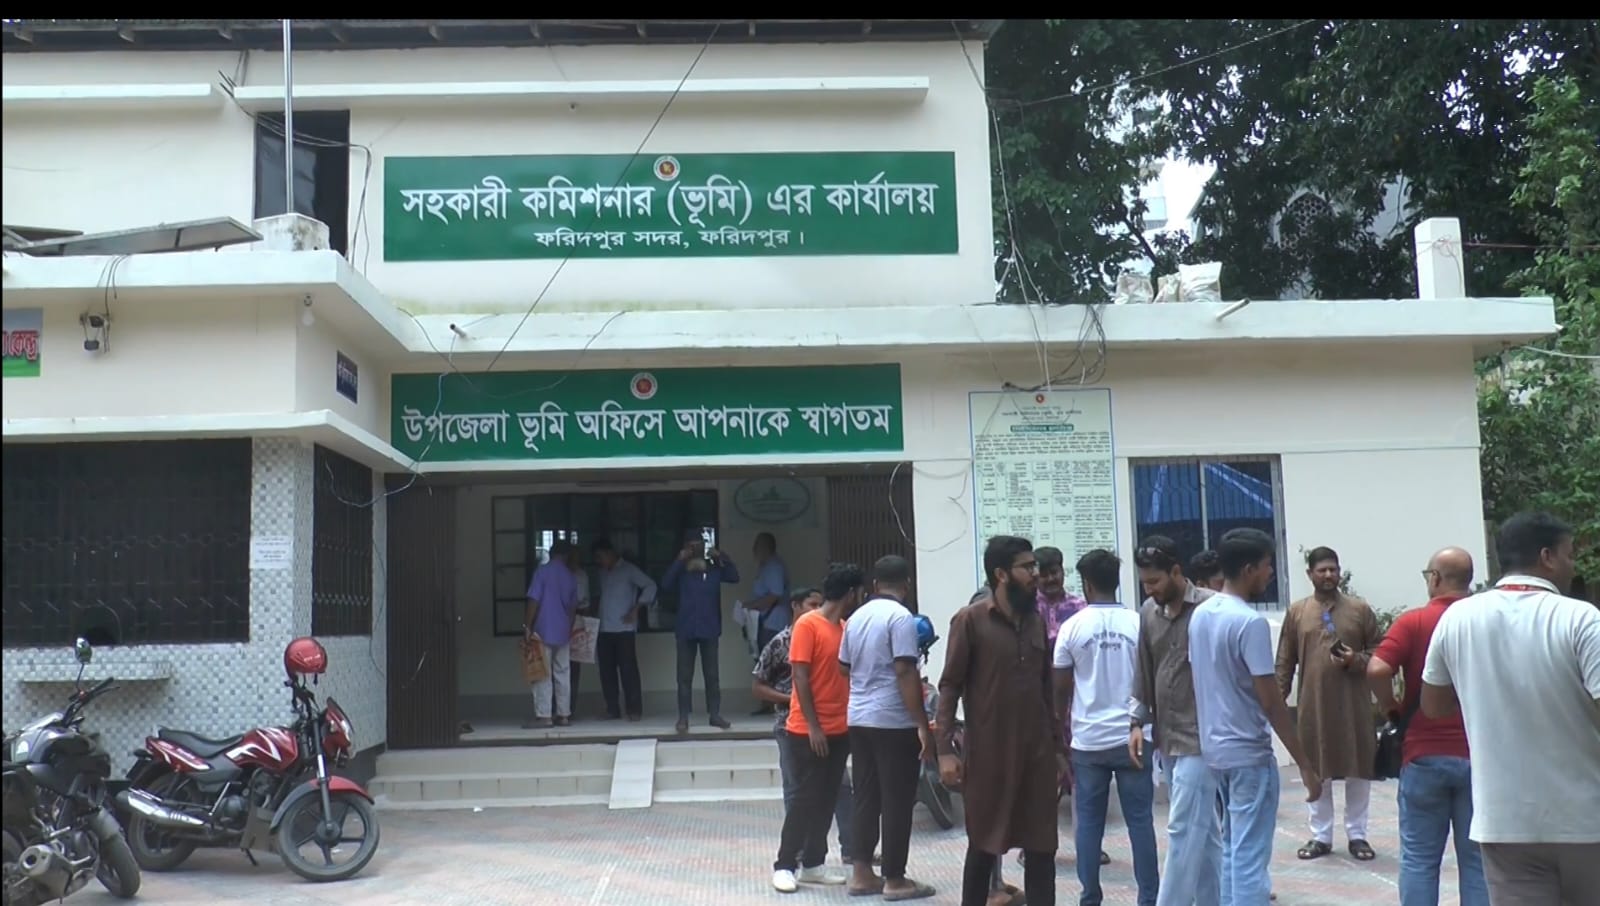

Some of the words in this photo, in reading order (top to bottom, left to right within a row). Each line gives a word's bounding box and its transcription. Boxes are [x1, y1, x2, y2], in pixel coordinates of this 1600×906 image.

[400, 176, 513, 223] সহকারী
[519, 176, 656, 219] কমিশনার
[666, 174, 752, 227] (ভূমি)
[767, 184, 815, 217] এর
[823, 171, 939, 216] কার্যালয়
[534, 228, 626, 250] ফরিদপুর
[633, 231, 689, 249] সদর,
[698, 226, 790, 248] ফরিদপুর
[401, 404, 510, 444] উপজেলা
[517, 401, 569, 452] ভূমি
[575, 400, 666, 441] অফিসে
[673, 404, 792, 438] আপনাকে
[797, 401, 893, 436] স্বাগতম
